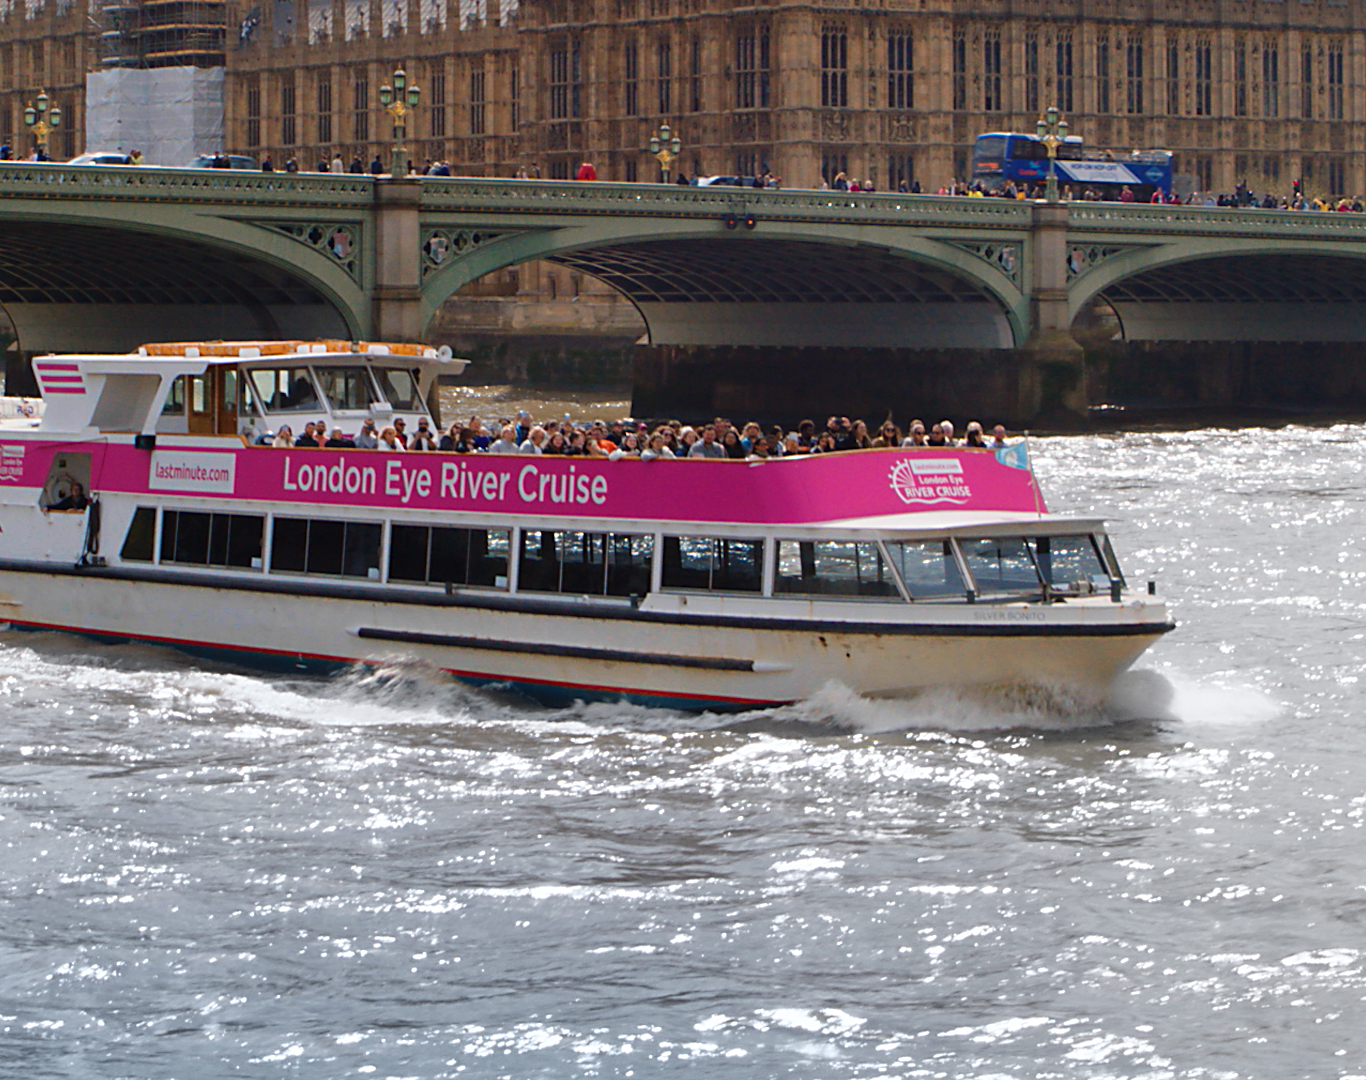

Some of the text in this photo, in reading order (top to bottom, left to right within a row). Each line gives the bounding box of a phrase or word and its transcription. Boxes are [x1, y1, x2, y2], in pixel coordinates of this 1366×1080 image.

[155, 461, 230, 481] lastminute.com
[283, 456, 608, 505] London Eye River Cruise
[918, 474, 964, 486] London Eye
[904, 486, 972, 497] RIVER CRUISE
[973, 611, 1046, 621] SILVER BONITO
